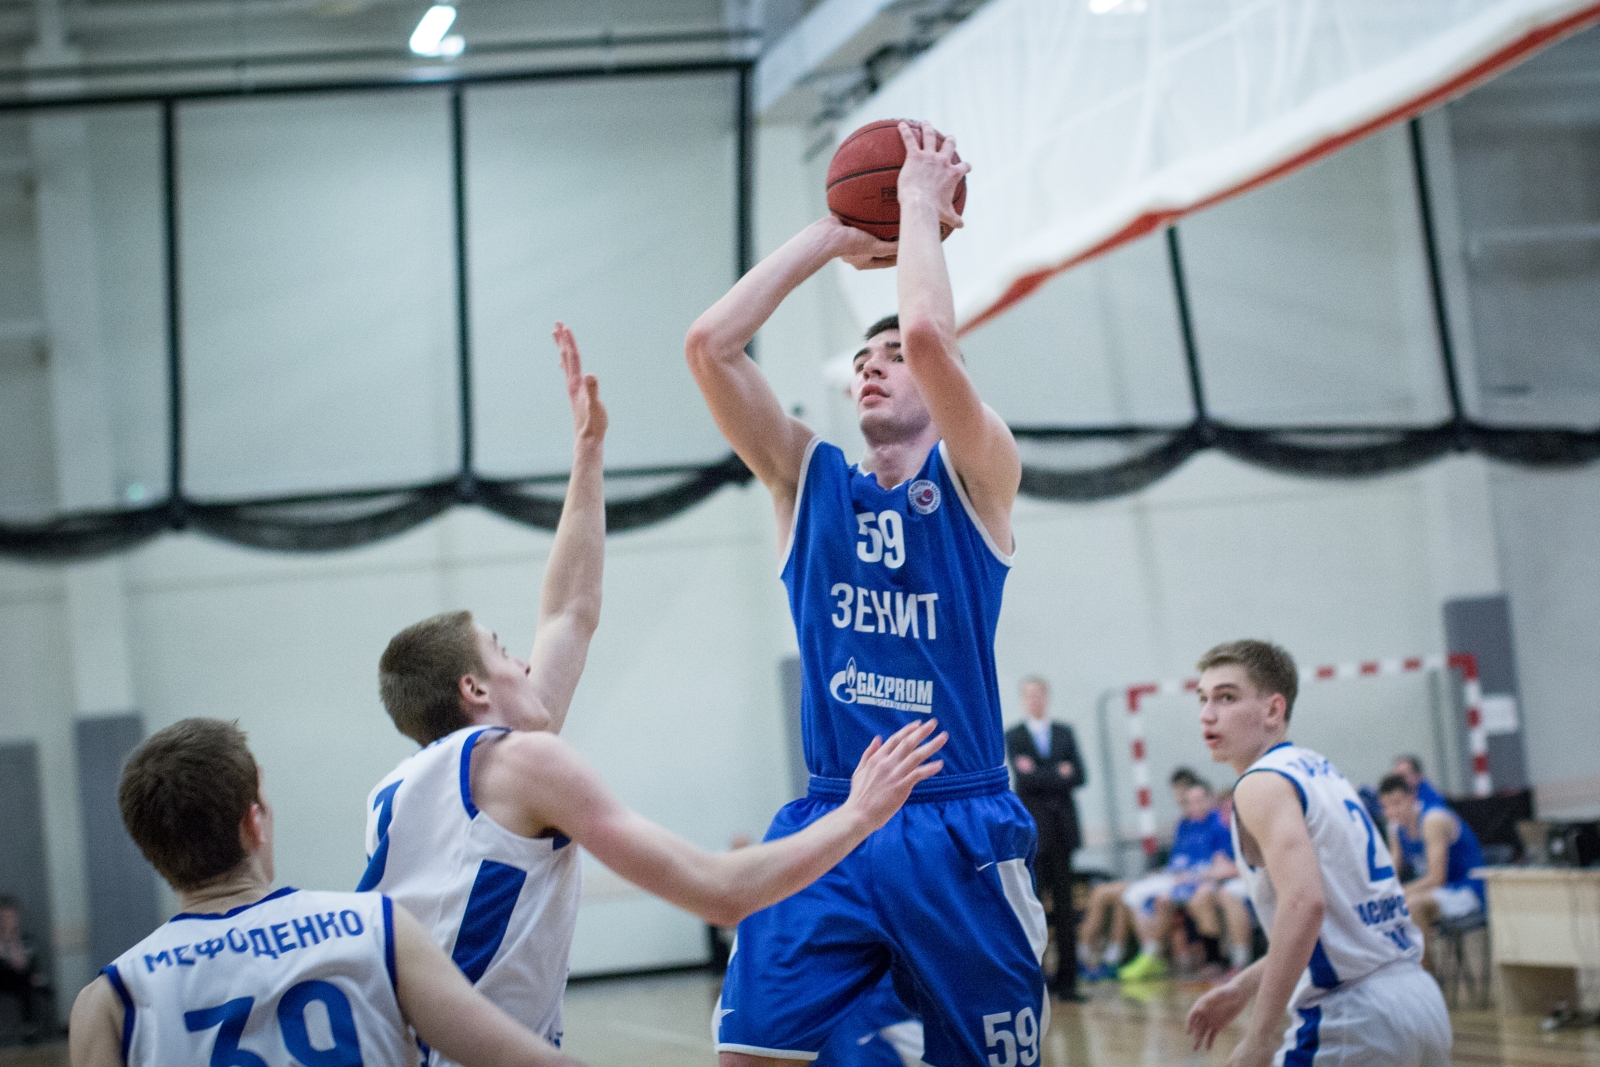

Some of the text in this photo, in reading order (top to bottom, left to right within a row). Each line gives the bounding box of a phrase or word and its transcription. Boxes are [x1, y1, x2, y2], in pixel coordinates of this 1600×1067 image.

[856, 509, 906, 569] 59
[830, 583, 939, 640] ЗЕНИТ
[856, 671, 934, 705] GAZPROM
[1343, 798, 1395, 883] 2
[143, 909, 364, 973] МЕФОДЕНКО
[982, 1006, 1039, 1067] 59
